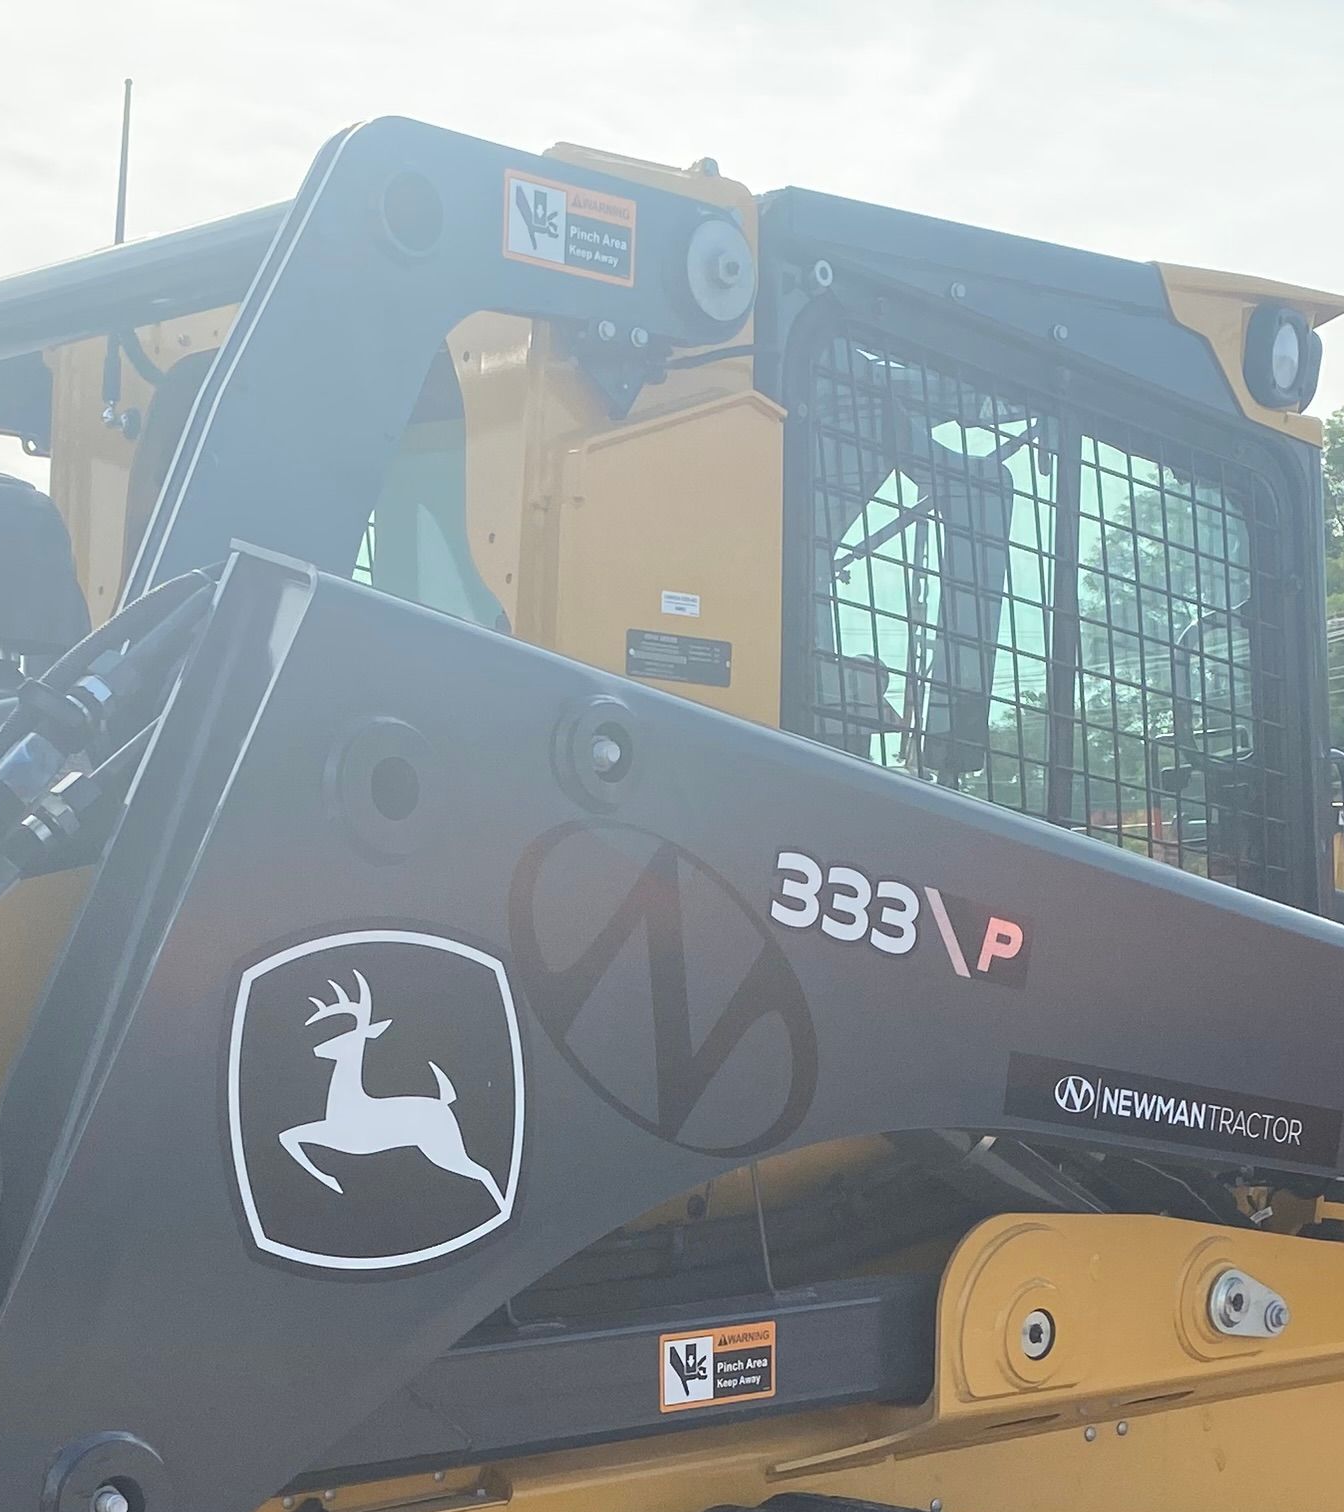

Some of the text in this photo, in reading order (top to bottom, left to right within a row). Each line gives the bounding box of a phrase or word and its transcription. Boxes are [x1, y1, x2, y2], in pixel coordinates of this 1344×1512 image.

[580, 197, 630, 220] WARNING
[569, 225, 627, 251] Pinch Area
[568, 244, 619, 268] Keep Away
[727, 1330, 770, 1345] WARNING
[716, 1357, 768, 1374] Pinch Area
[716, 1374, 762, 1389] Keep Away
